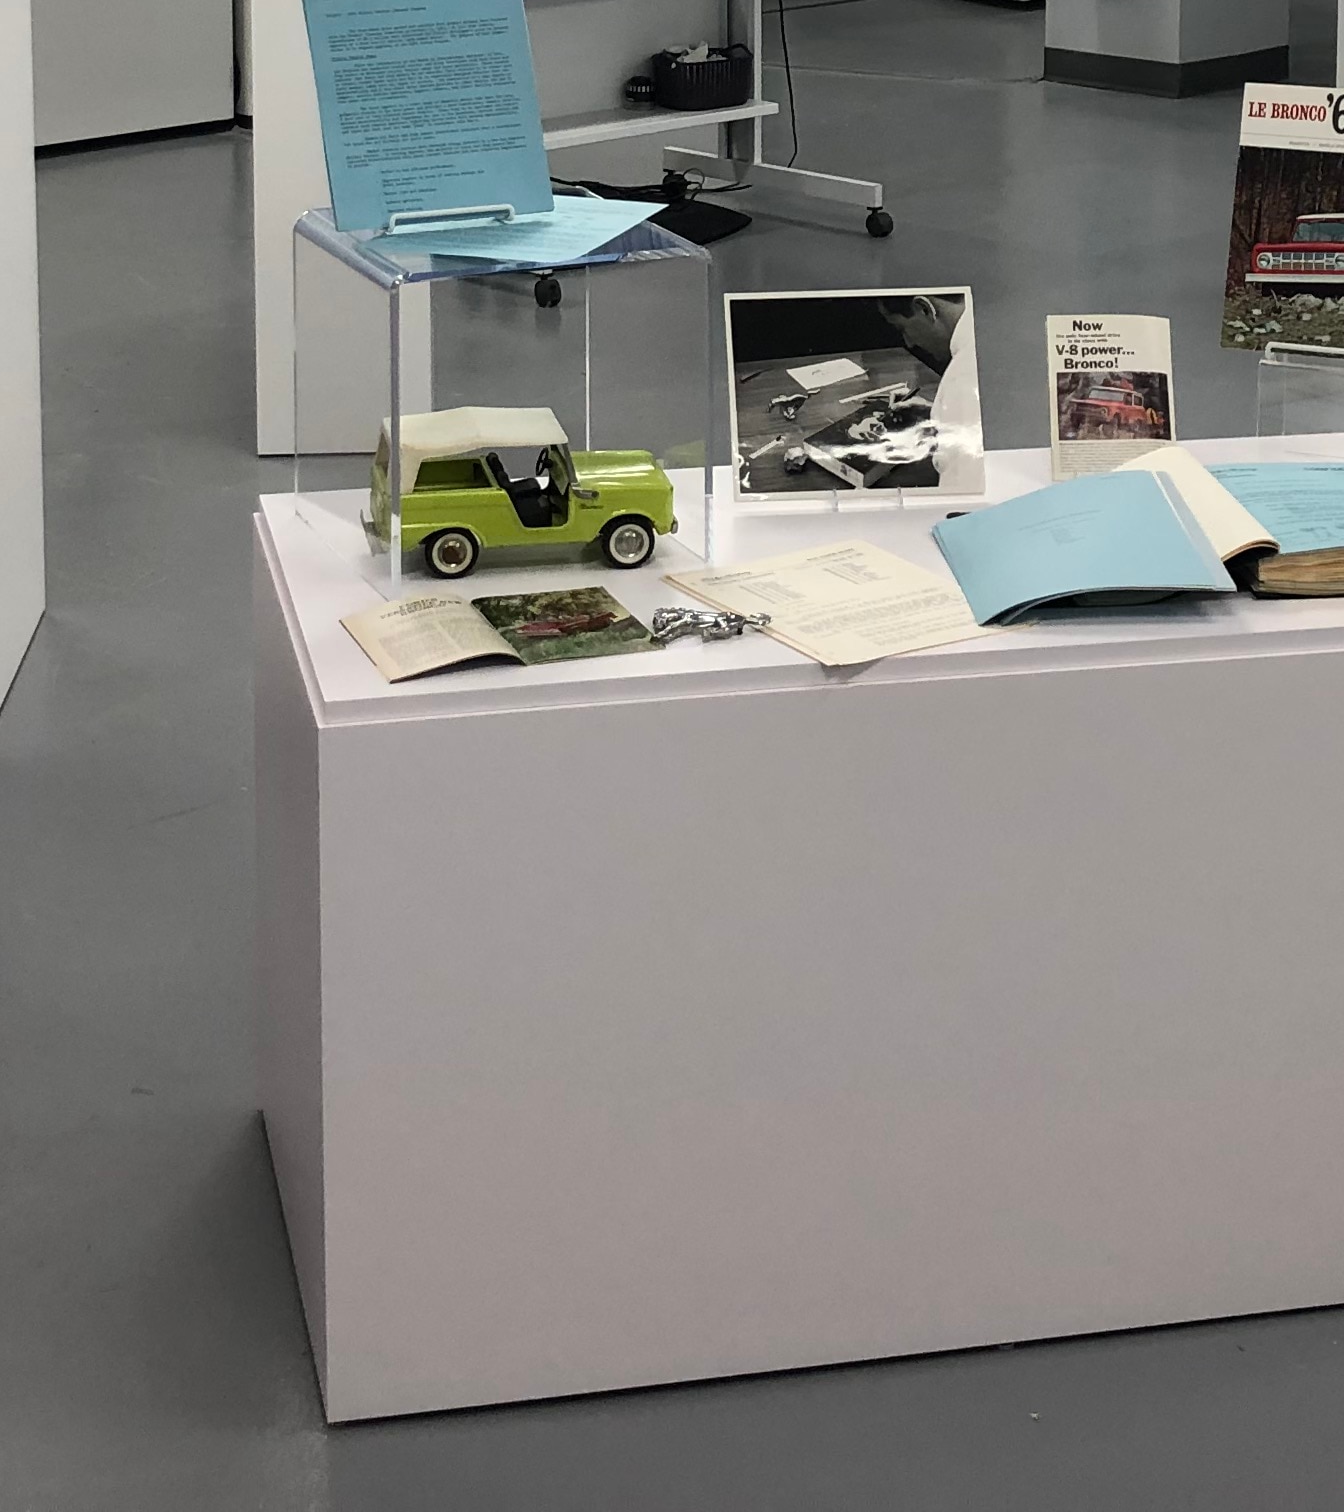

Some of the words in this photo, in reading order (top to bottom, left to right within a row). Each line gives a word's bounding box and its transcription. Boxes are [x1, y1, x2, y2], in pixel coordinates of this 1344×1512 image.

[1247, 101, 1267, 118] LE
[1271, 103, 1327, 122] BRONCO
[1072, 320, 1103, 332] Now
[1056, 344, 1078, 356] V-8
[1082, 344, 1135, 358] power...
[1064, 357, 1119, 370] Bronco!
